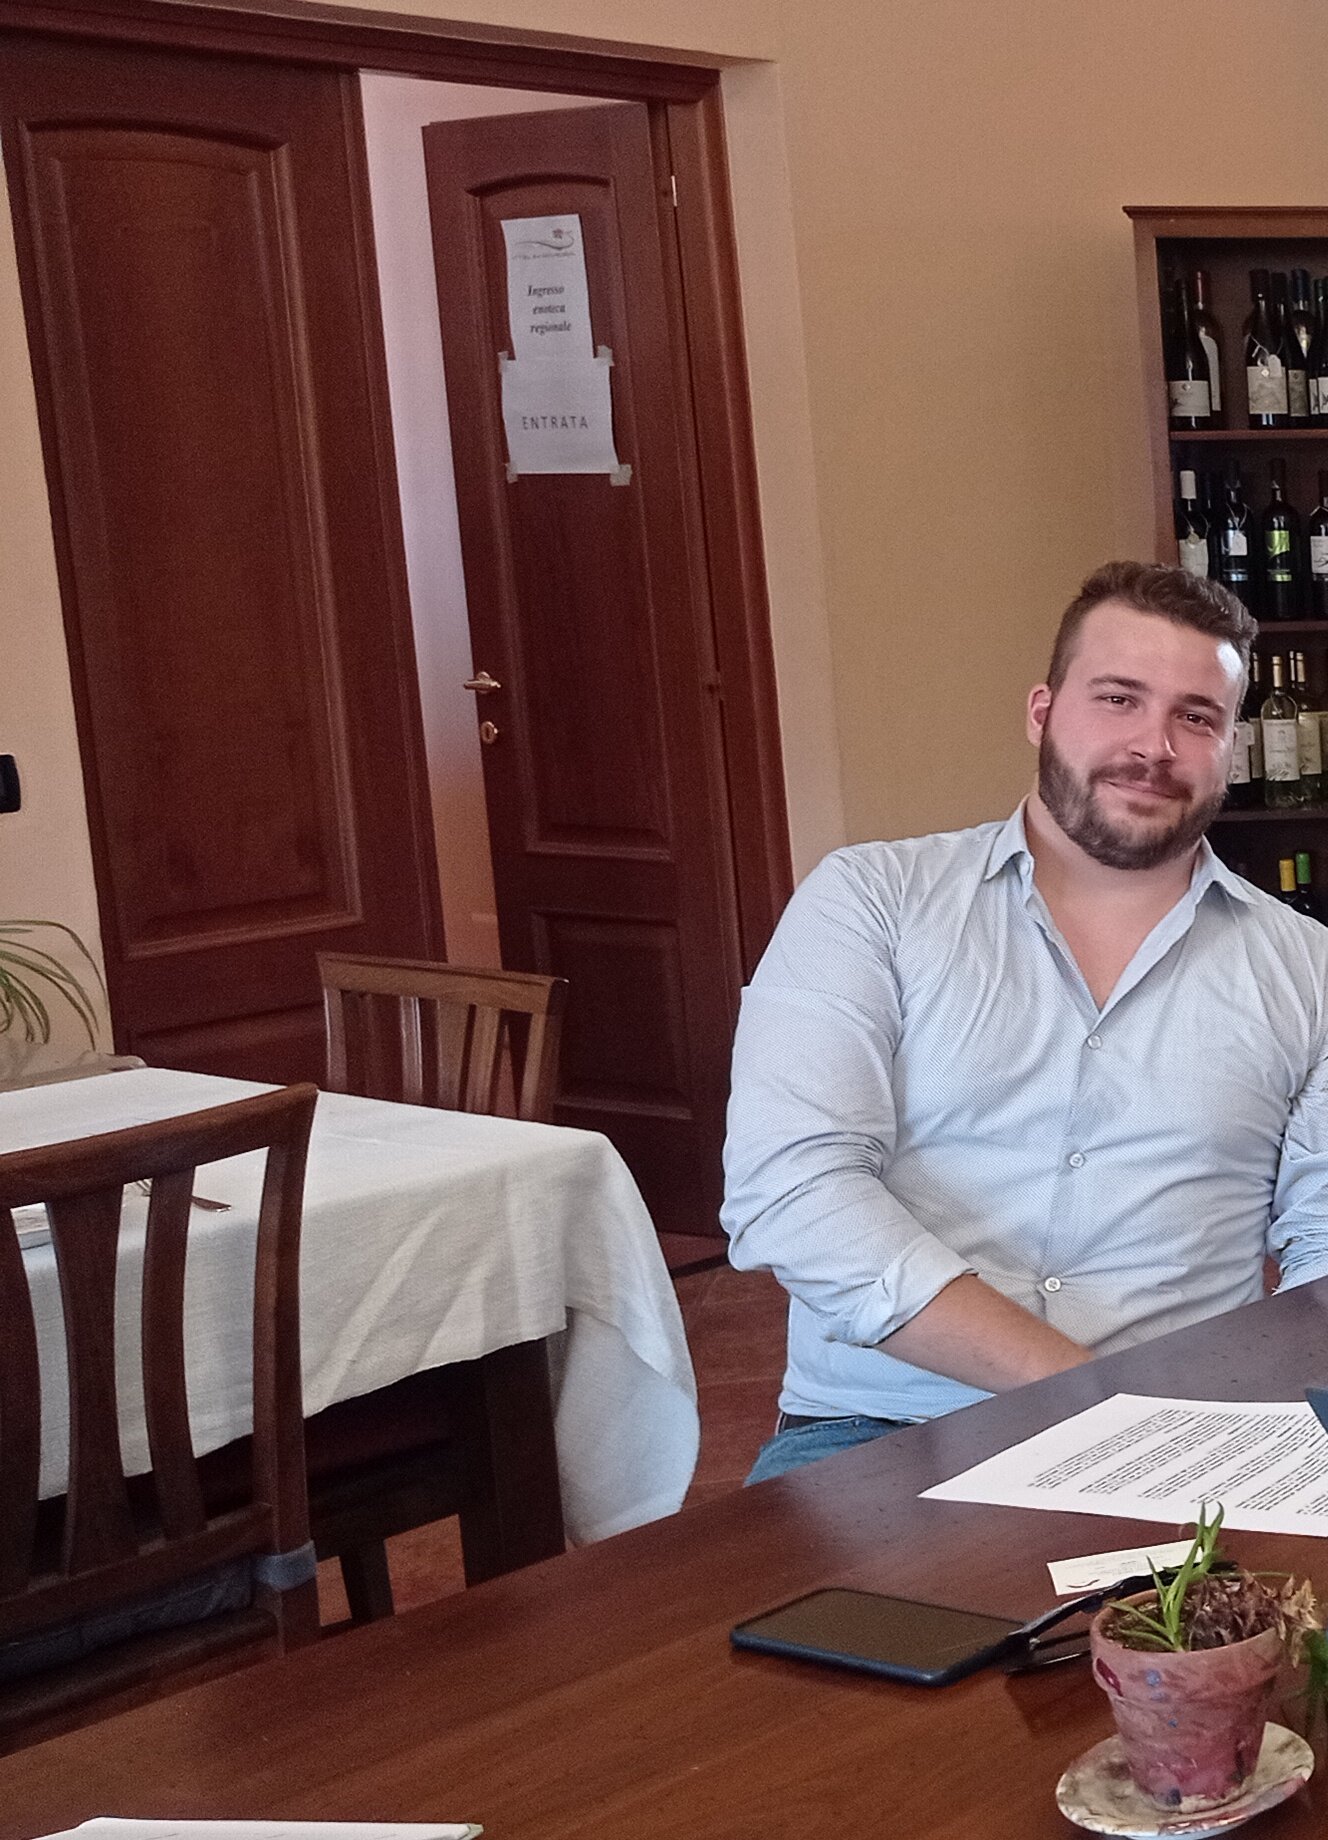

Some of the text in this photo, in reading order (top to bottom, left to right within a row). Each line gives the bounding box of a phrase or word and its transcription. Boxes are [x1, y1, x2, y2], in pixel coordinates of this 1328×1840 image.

[527, 285, 565, 298] Ingresso
[532, 304, 566, 315] enoteca
[530, 322, 571, 337] regionale
[522, 415, 589, 430] ENTRATA
